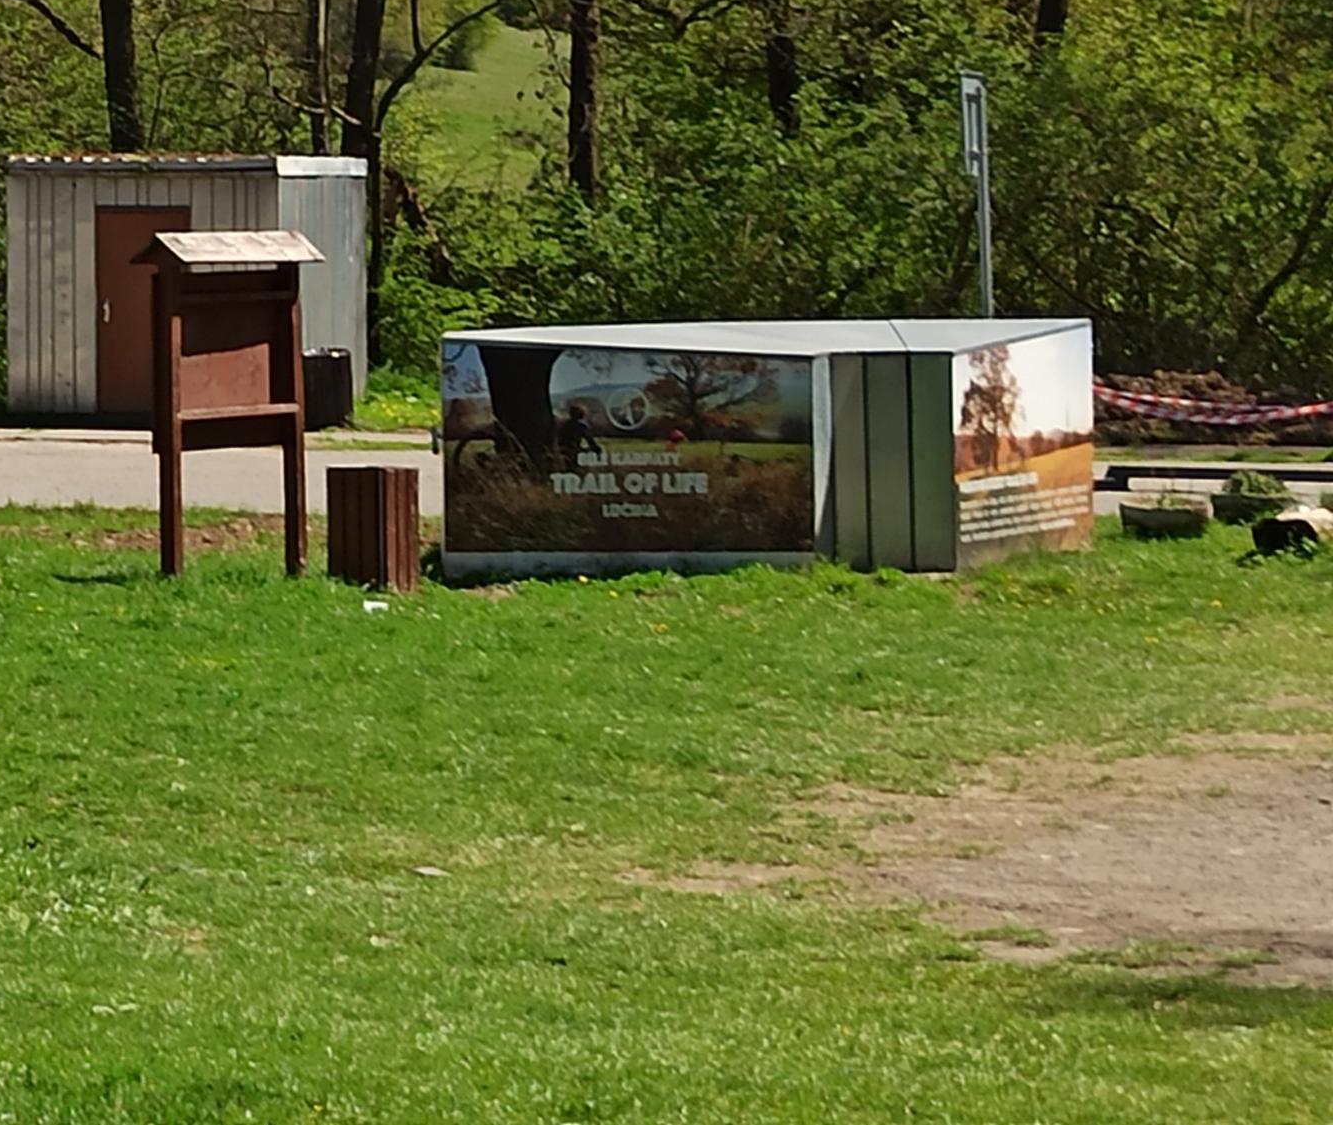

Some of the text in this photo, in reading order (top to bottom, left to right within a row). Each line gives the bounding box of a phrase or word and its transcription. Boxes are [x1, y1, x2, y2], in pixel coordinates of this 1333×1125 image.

[549, 472, 709, 495] TRAIL OF LIFE
